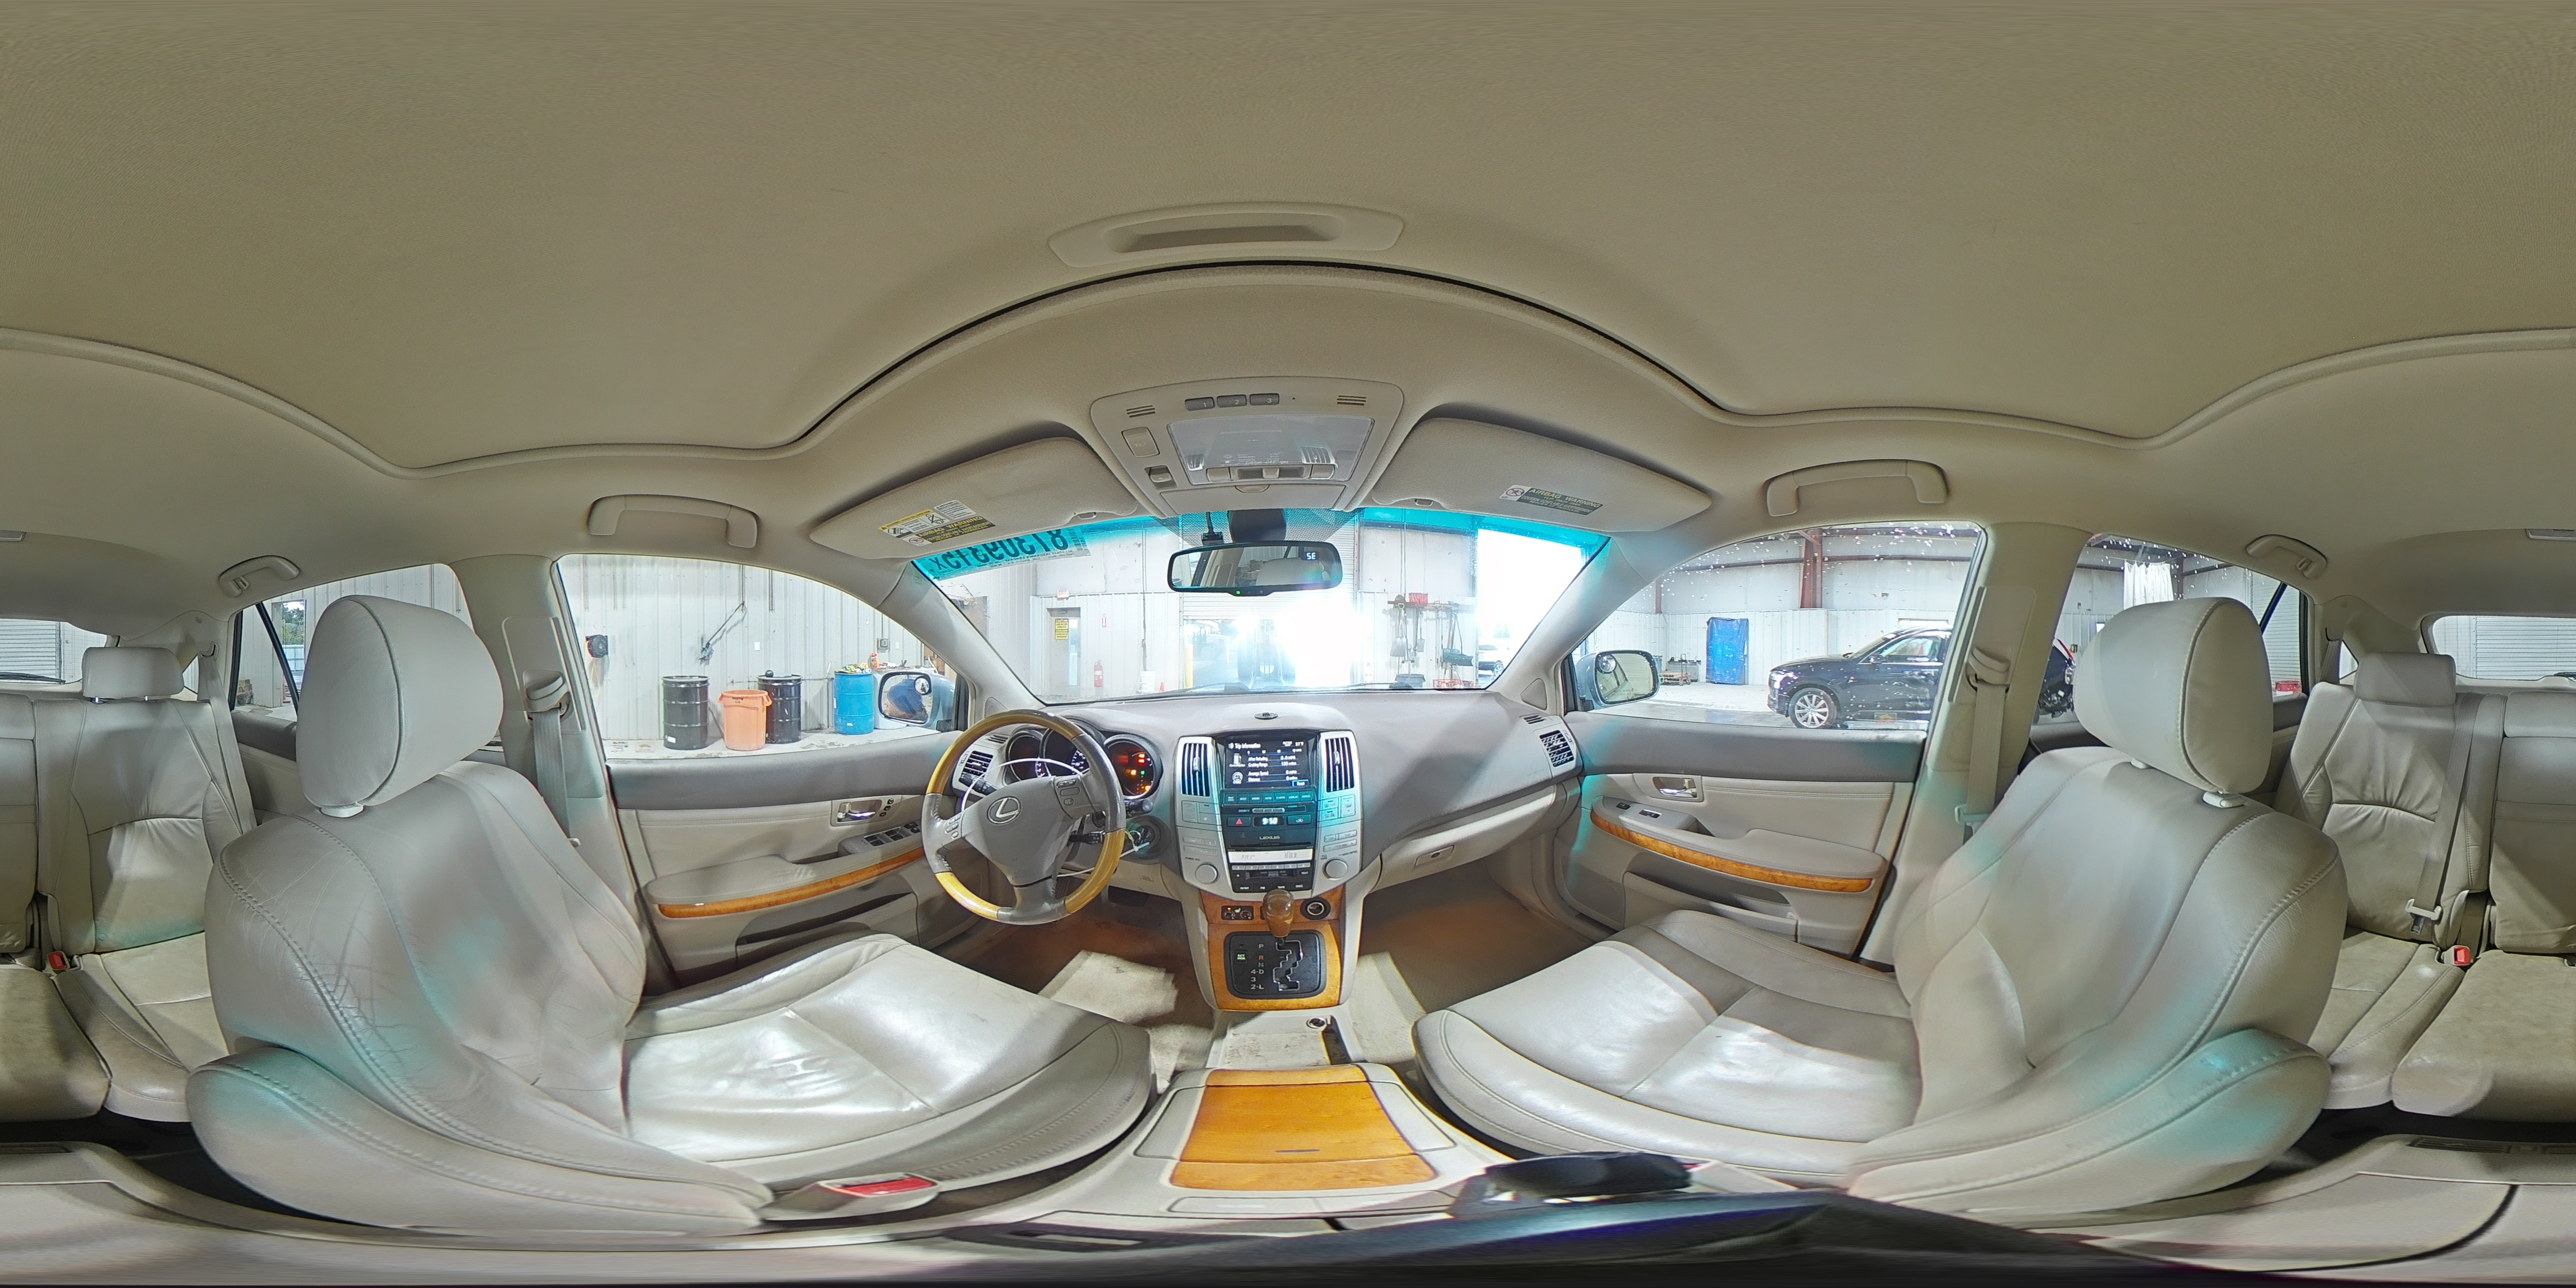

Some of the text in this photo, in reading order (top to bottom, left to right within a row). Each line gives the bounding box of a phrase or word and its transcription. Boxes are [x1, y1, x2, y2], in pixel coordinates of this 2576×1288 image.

[1529, 489, 1601, 508] AIRBAG WARNING
[918, 517, 983, 537] AIRBAG WARNING
[1262, 817, 1278, 825] 9:50
